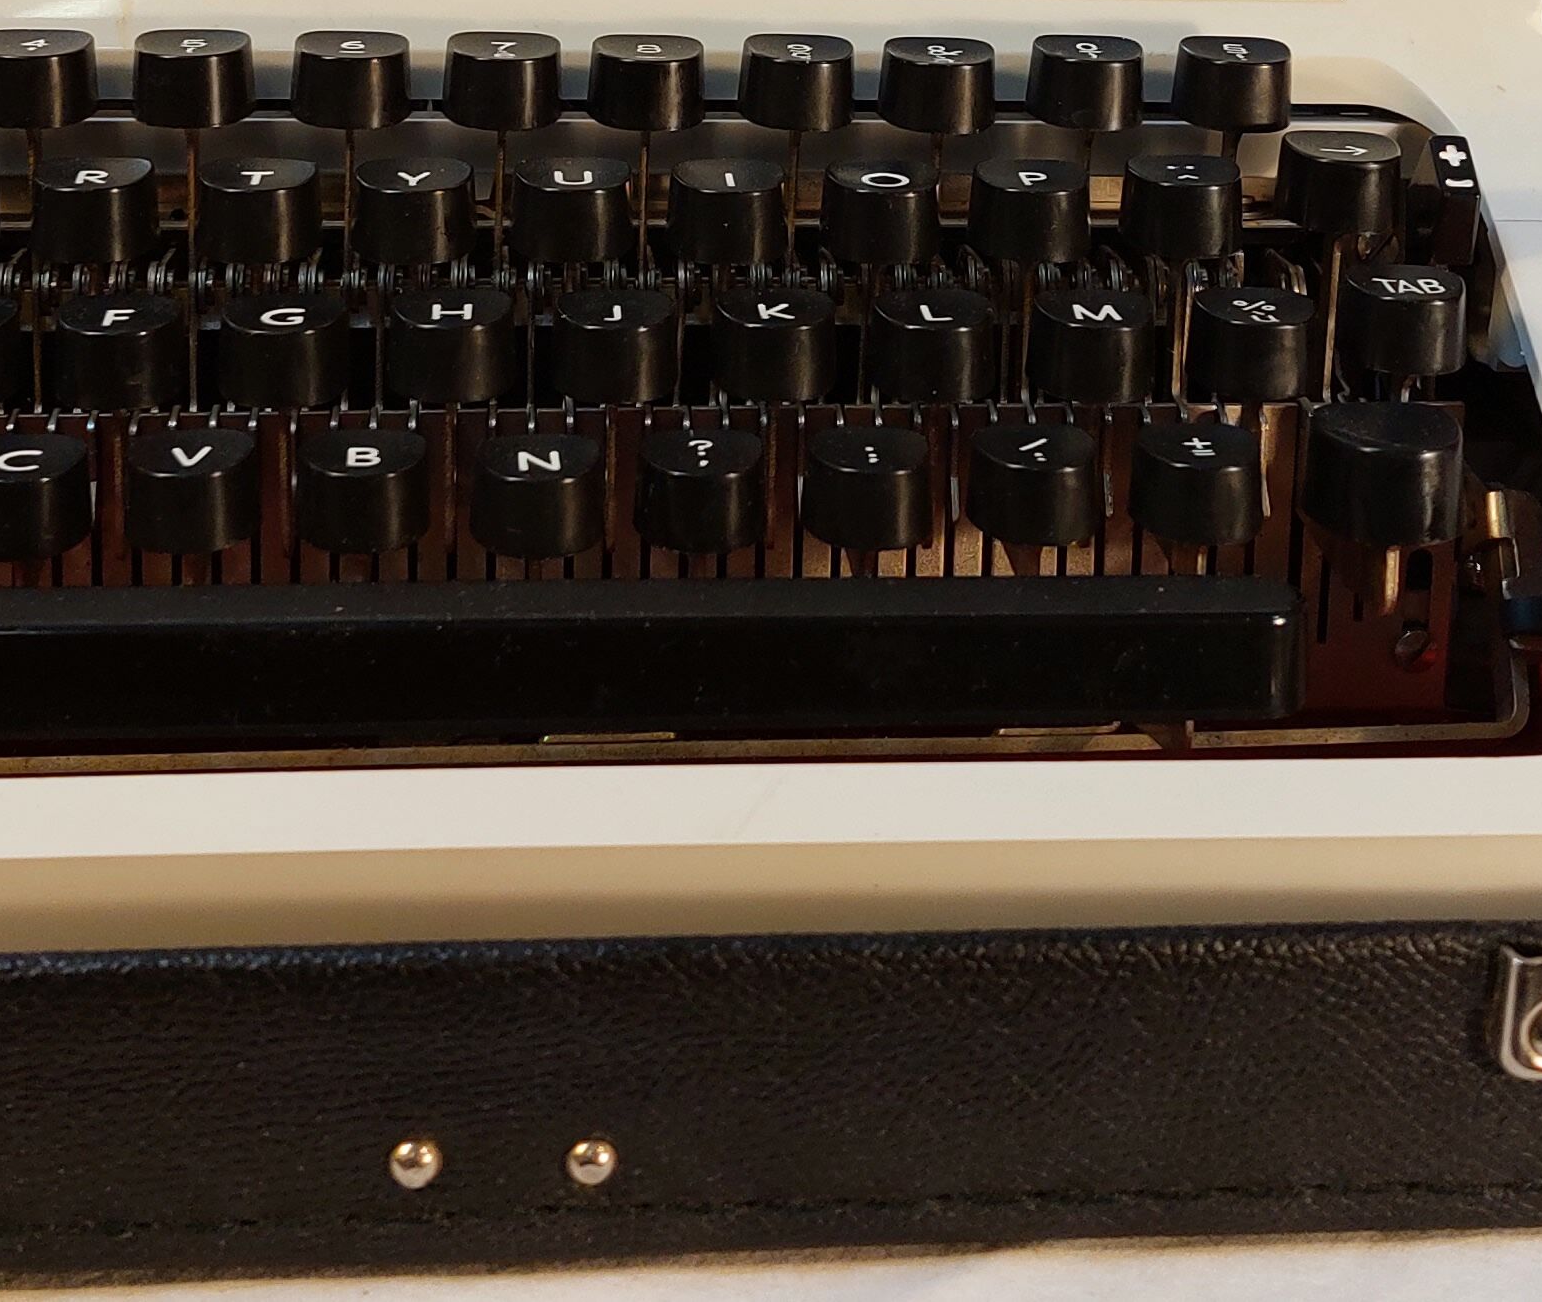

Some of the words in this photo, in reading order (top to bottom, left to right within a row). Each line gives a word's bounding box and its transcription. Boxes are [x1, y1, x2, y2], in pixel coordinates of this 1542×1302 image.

[74, 170, 109, 185] R
[240, 170, 275, 186] T
[397, 171, 431, 187] Y
[553, 170, 593, 186] U
[724, 172, 736, 187] I
[860, 172, 910, 188] O
[1018, 171, 1048, 186] P
[1371, 277, 1447, 295] TAB
[101, 309, 136, 327] F
[260, 307, 306, 326] G
[431, 303, 473, 320] H
[603, 304, 622, 322] J
[757, 303, 796, 320] K
[919, 304, 953, 322] L
[1072, 304, 1123, 321] M
[171, 445, 213, 467] V
[346, 446, 382, 467] B
[517, 450, 561, 472] N
